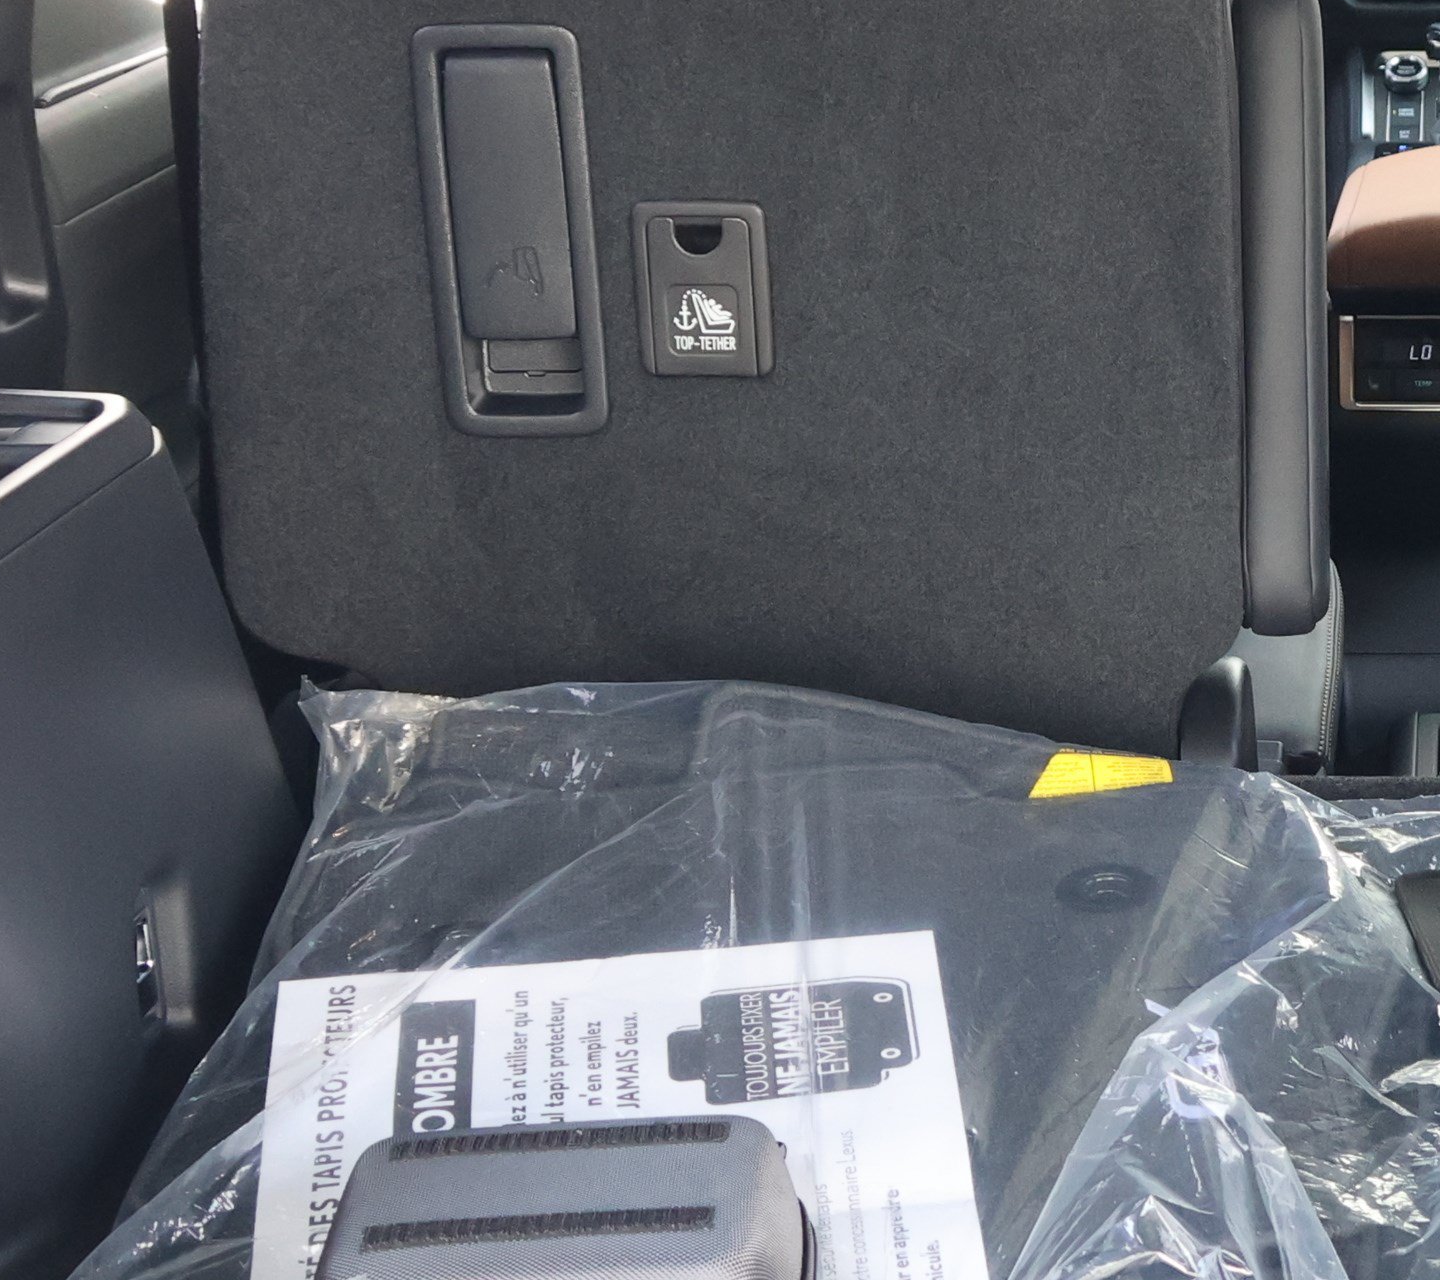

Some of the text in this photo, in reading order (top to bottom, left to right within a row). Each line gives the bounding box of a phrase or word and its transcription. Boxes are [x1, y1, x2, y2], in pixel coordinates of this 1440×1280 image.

[674, 335, 737, 351] TOP-TETHER
[505, 990, 534, 1028] qu'un
[545, 997, 570, 1068] protecteur,
[811, 998, 850, 1076] EMPILER
[503, 1032, 528, 1089] n'utiliser
[578, 1020, 607, 1106] n'en empilez
[740, 992, 769, 1100] TOUJOURS FIXER
[769, 990, 811, 1095] NE JAMAIS
[412, 1034, 459, 1133] OMBRE
[543, 1072, 570, 1107] tapis
[615, 1049, 640, 1108] JAMAIS
[311, 1129, 344, 1192] TAPIS
[894, 1252, 911, 1268] en
